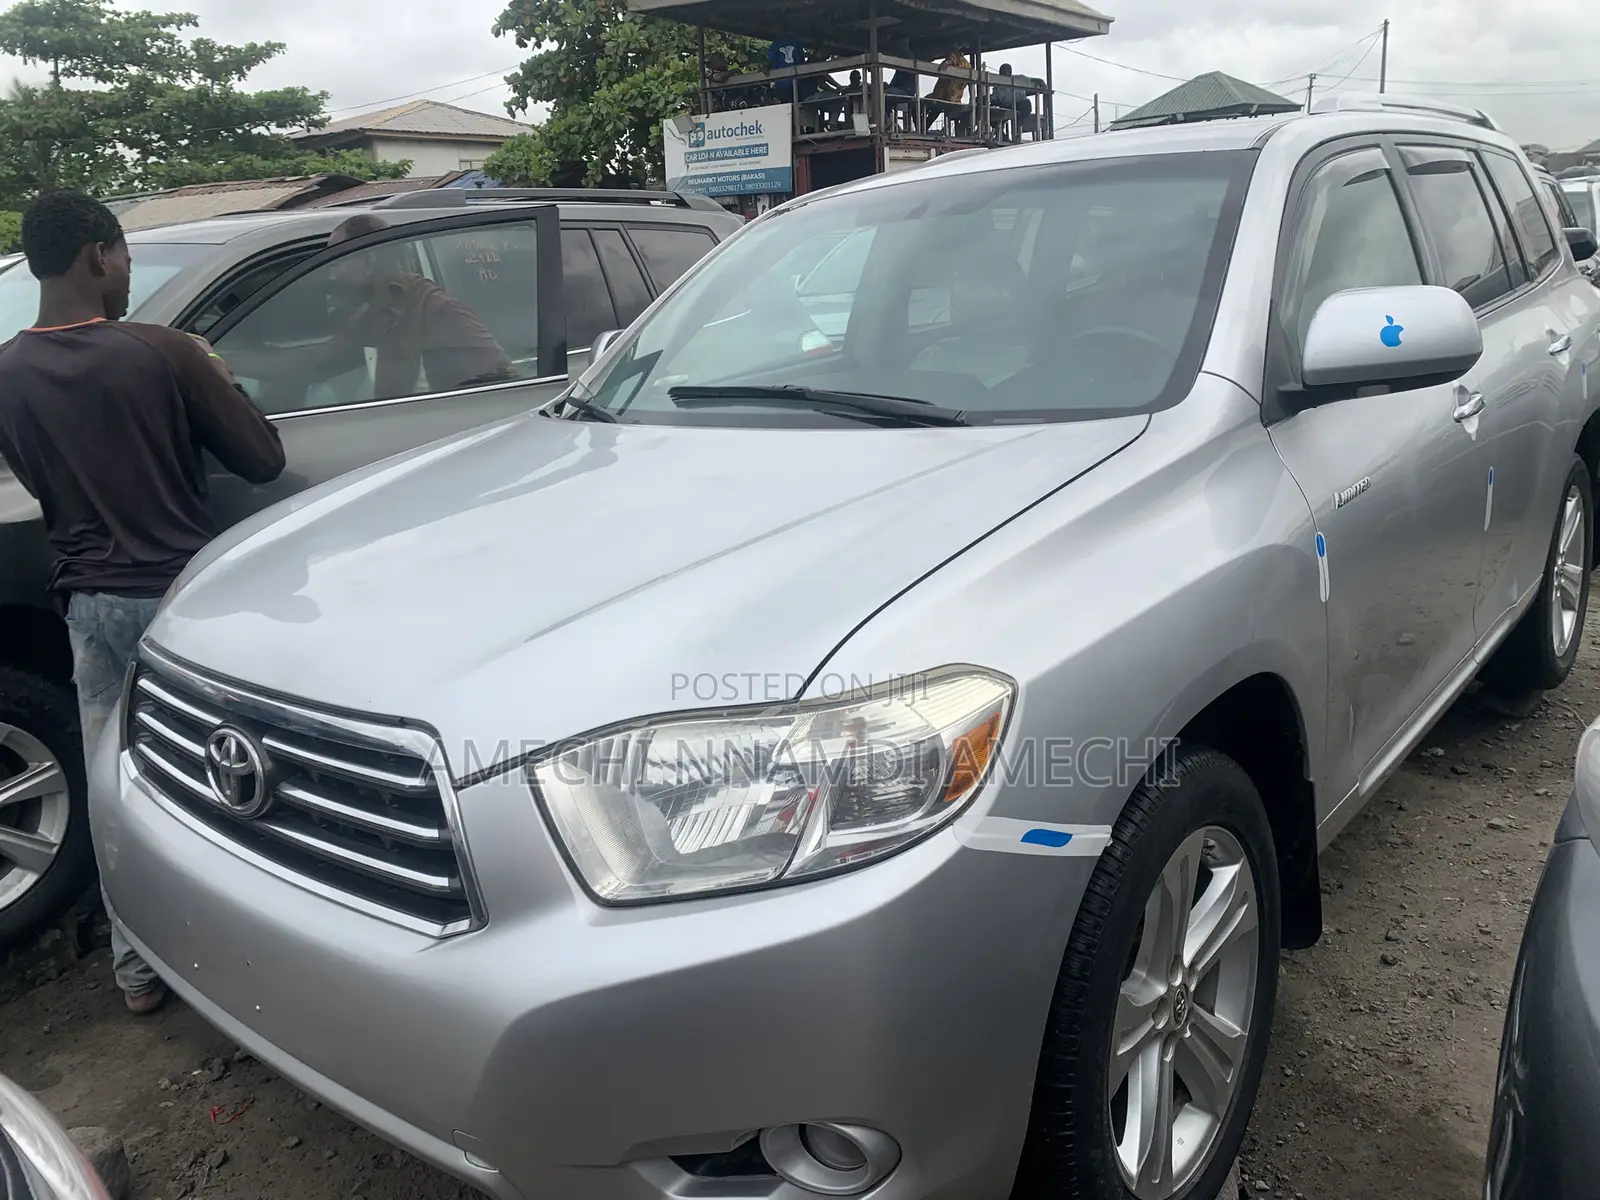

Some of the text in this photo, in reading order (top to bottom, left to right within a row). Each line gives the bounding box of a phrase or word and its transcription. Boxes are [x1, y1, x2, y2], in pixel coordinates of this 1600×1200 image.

[707, 120, 763, 140] autochek
[685, 146, 767, 162] CAR LOAN AVAILABLE HERE
[687, 172, 766, 185] NEUMARKT MOTORS (BAKASI)
[1332, 476, 1371, 510] LIMITED
